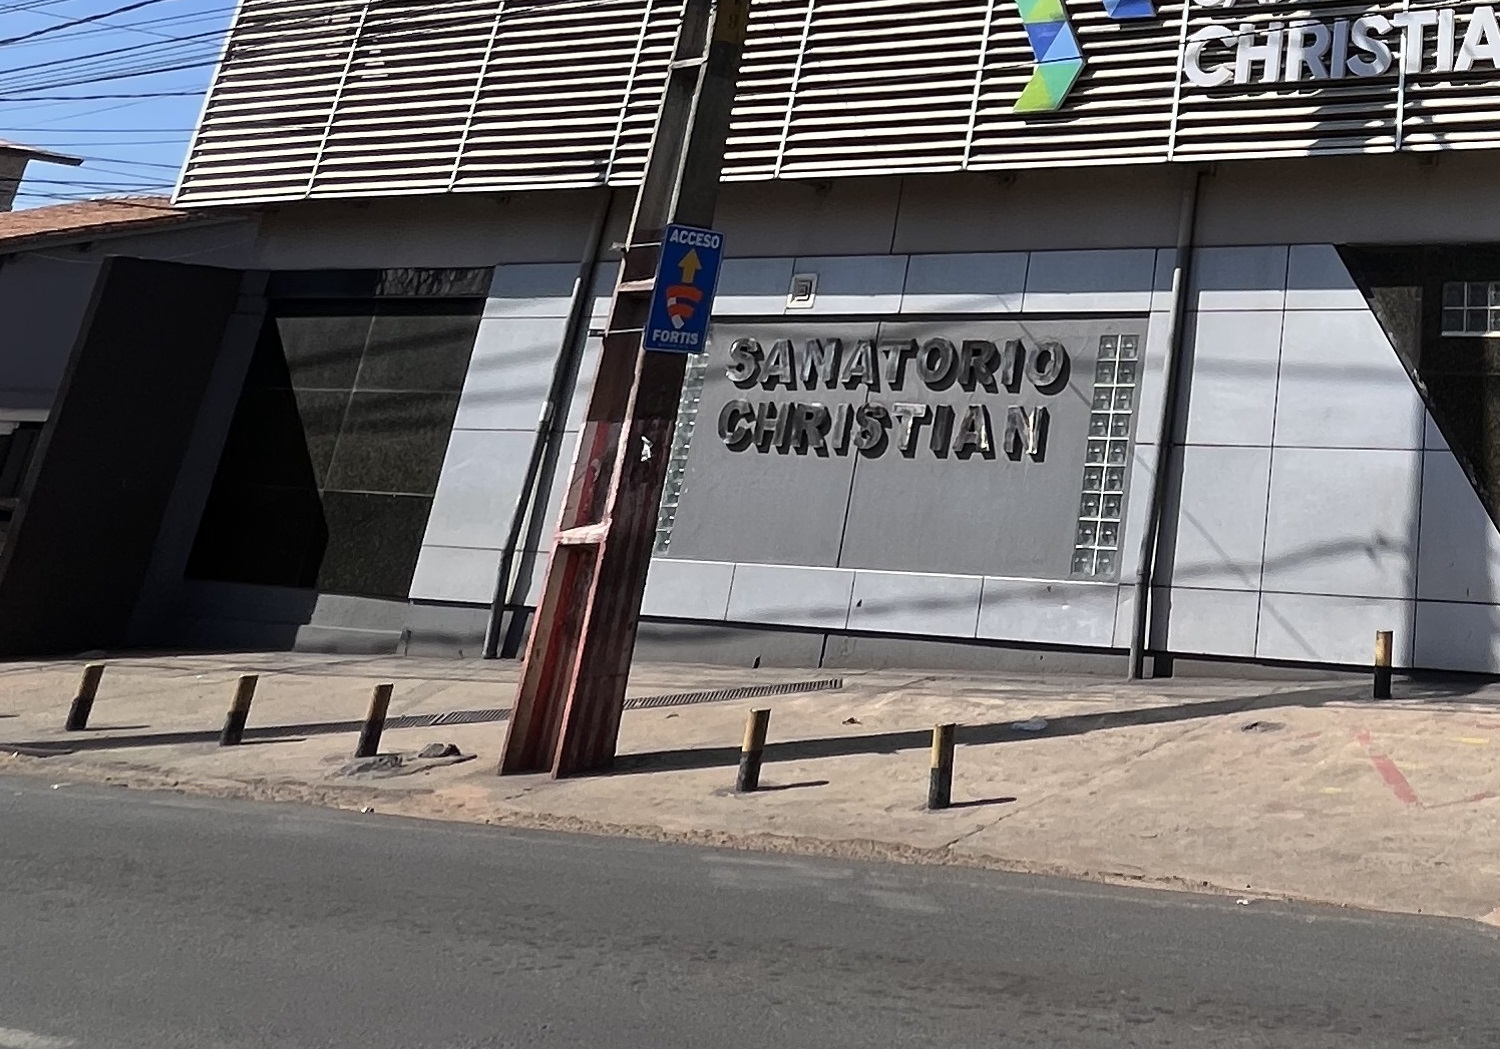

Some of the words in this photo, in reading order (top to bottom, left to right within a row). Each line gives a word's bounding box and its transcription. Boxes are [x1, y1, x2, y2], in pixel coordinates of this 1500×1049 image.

[669, 228, 721, 250] ACCESO
[652, 329, 699, 345] FORTIS
[725, 336, 1069, 394] SANATORIO
[717, 399, 1050, 462] CHRISTIAN
